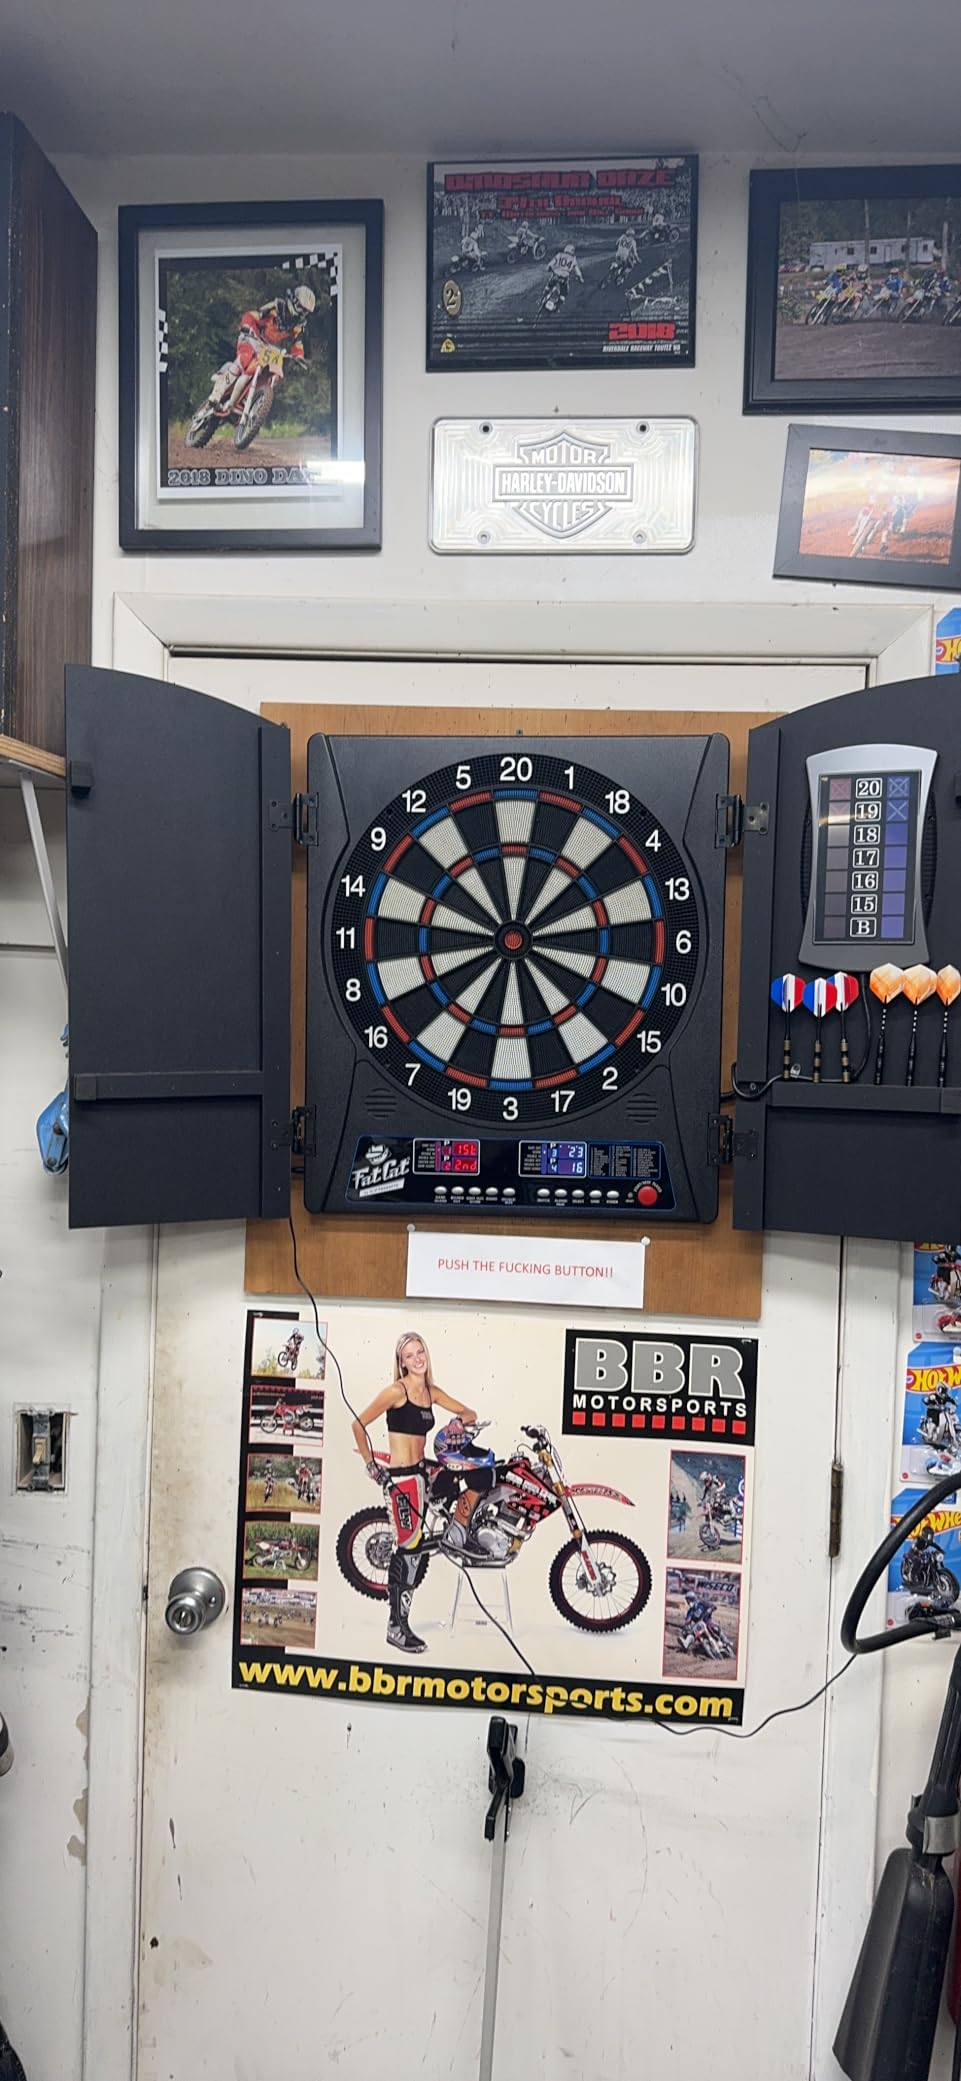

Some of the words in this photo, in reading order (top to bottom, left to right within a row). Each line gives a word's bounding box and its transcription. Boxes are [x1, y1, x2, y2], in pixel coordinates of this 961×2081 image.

[532, 443, 597, 464] MOTOR
[168, 469, 211, 486] 2018
[215, 467, 268, 485] DINO
[502, 471, 625, 494] HARLEY-DAVIDSON
[530, 501, 595, 530] CYCLES
[456, 766, 471, 789] 5
[500, 757, 532, 781] 20
[565, 766, 573, 789] 1
[858, 781, 880, 796] 20
[402, 790, 426, 812] 12
[605, 790, 629, 813] 18
[857, 804, 879, 819] 19
[371, 828, 386, 850] 9
[646, 830, 661, 851] 4
[856, 827, 877, 842] 18
[855, 850, 876, 865] 17
[342, 875, 365, 896] 14
[665, 878, 689, 900] 13
[854, 874, 876, 888] 16
[853, 897, 875, 912] 15
[336, 928, 354, 948] 11
[857, 920, 871, 935] B
[676, 930, 691, 953] 6
[346, 979, 360, 1001] 8
[662, 983, 686, 1006] 10
[365, 1026, 387, 1048] 16
[637, 1031, 661, 1052] 15
[406, 1064, 420, 1085] 7
[603, 1067, 617, 1089] 2
[448, 1088, 471, 1110] 19
[503, 1097, 518, 1120] 3
[551, 1091, 574, 1112] 17
[571, 1162, 583, 1173] 16
[438, 1259, 469, 1271] PUSH
[473, 1260, 495, 1272] THE
[499, 1262, 551, 1275] FUCKING
[555, 1265, 613, 1278] BUTTON!!
[574, 1337, 746, 1399] BBR
[573, 1393, 747, 1417] MOTORSPORTS
[239, 1661, 733, 1718] www.bbrmotorsports.com
